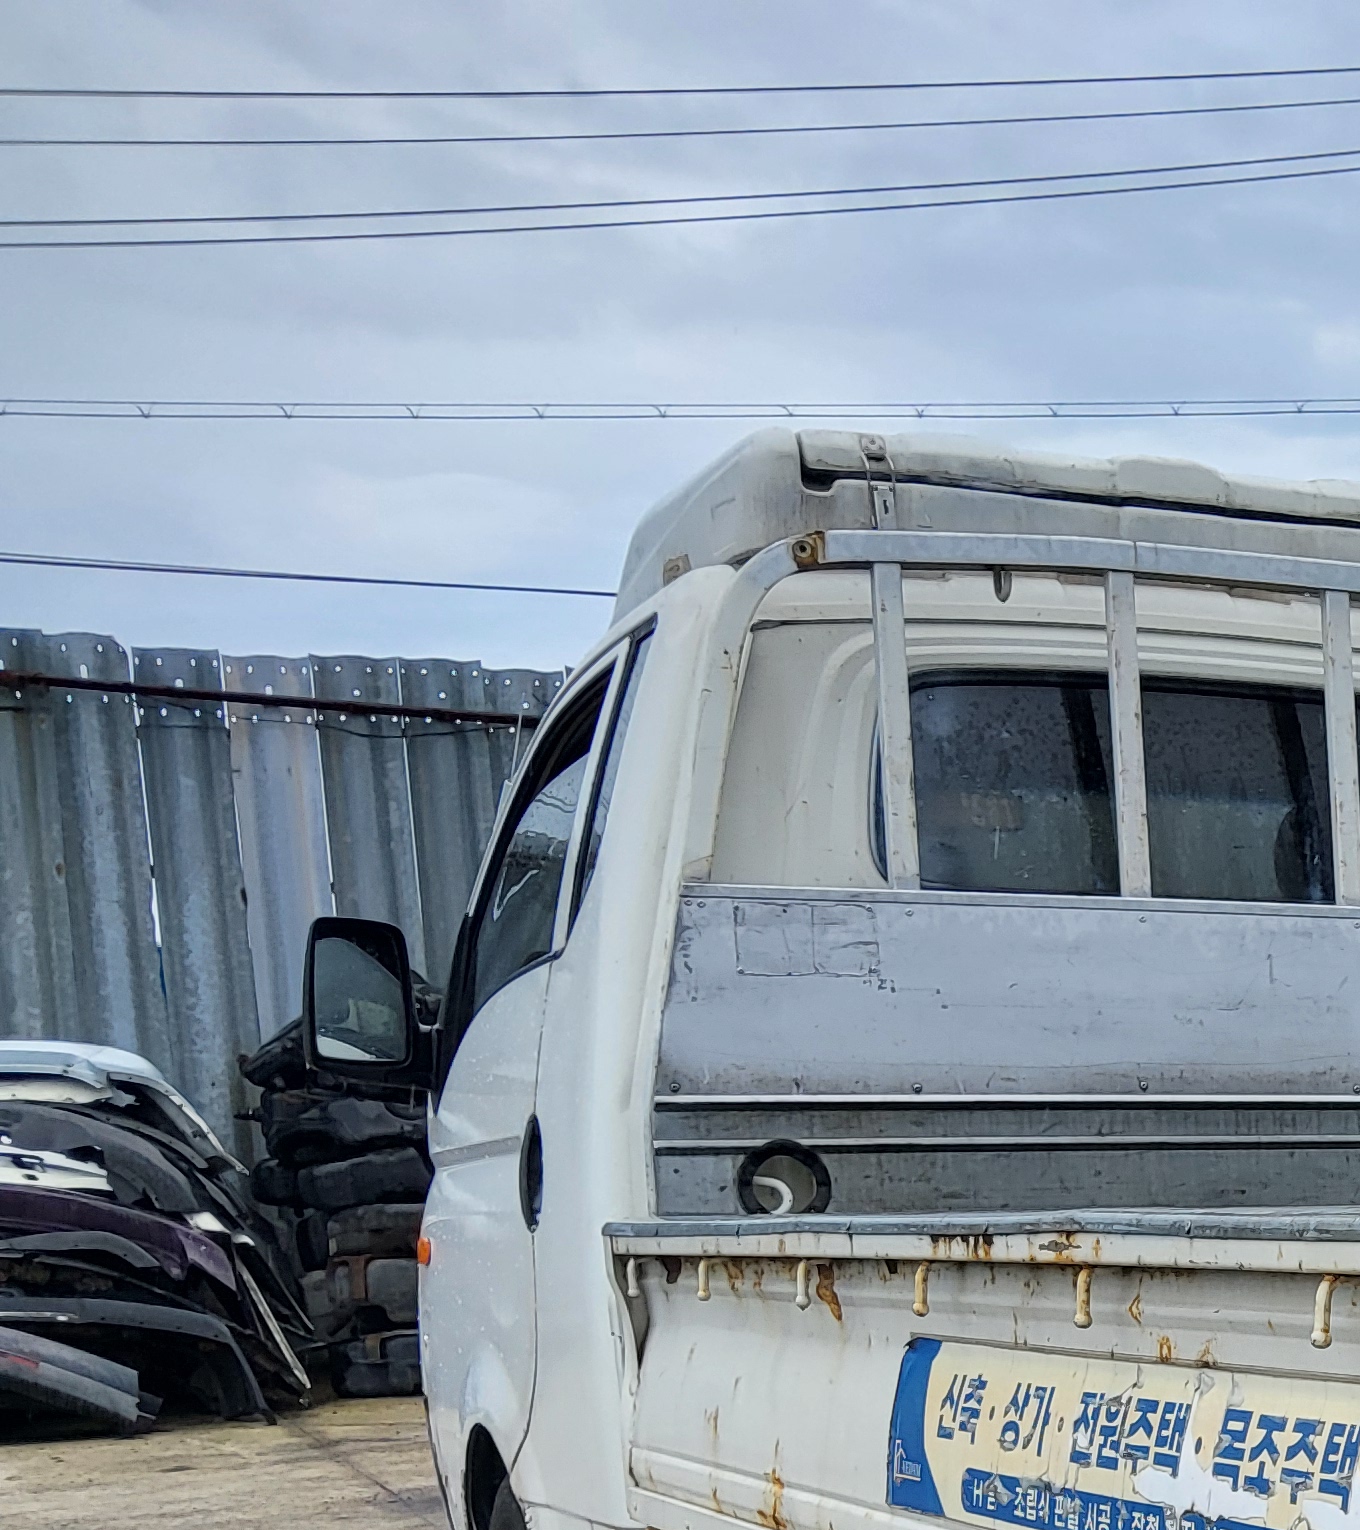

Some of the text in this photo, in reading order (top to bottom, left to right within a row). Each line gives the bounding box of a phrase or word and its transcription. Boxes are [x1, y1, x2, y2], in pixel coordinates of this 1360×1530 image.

[936, 1373, 989, 1446] 신축
[998, 1382, 1056, 1458] 상가
[1068, 1391, 1193, 1478] 전원주택
